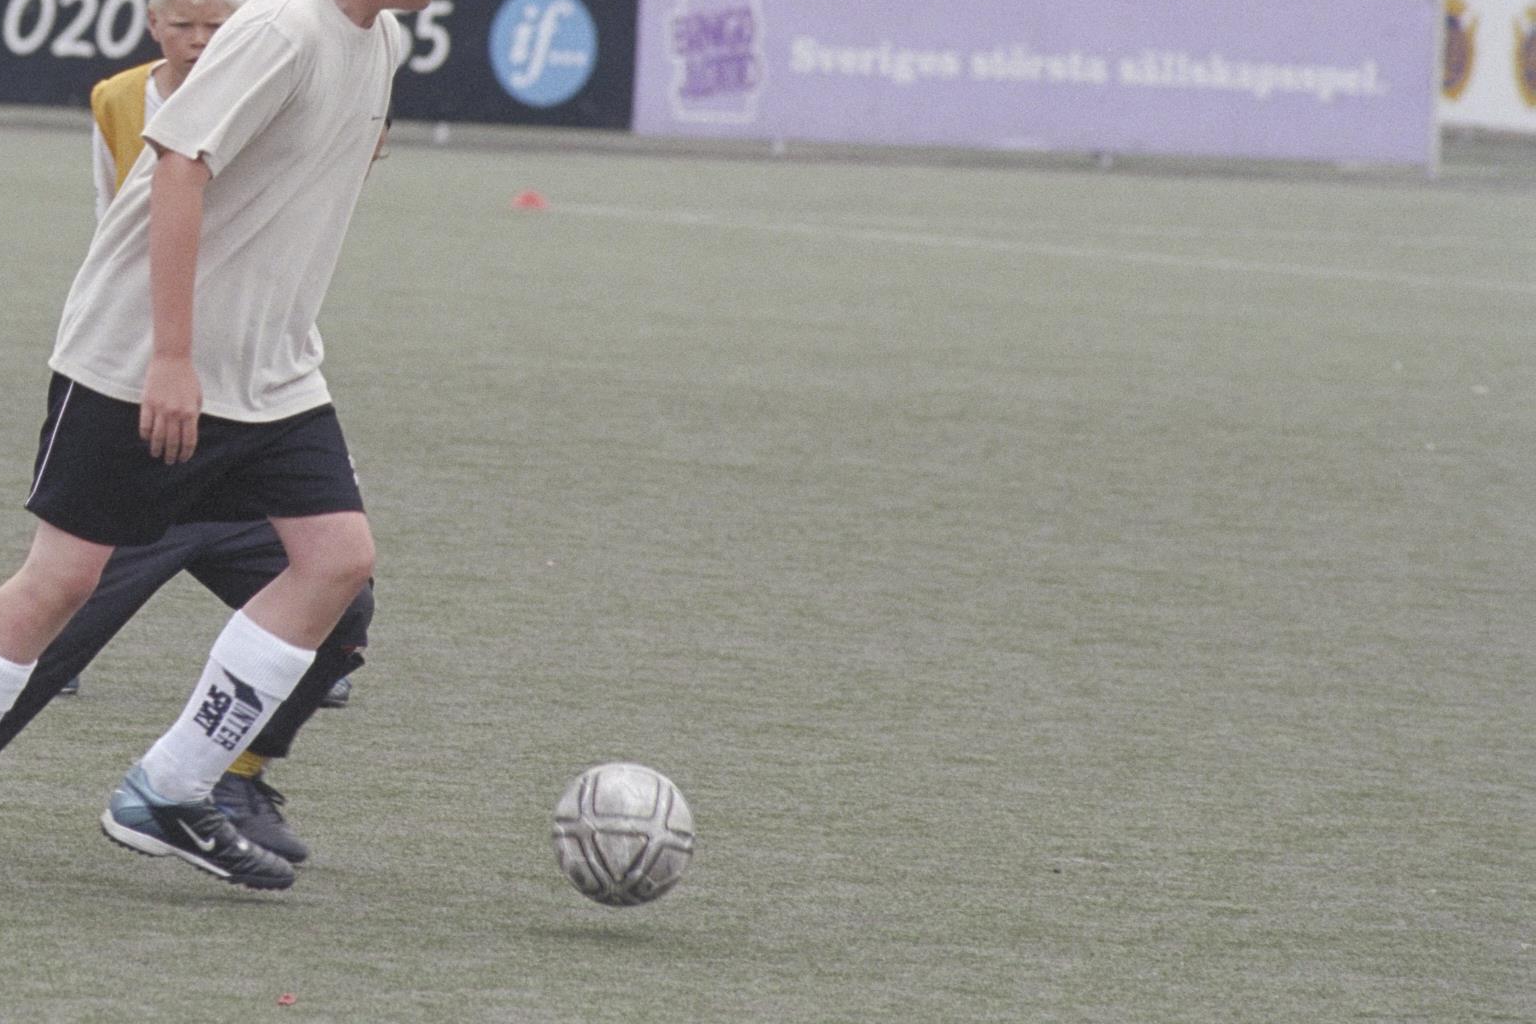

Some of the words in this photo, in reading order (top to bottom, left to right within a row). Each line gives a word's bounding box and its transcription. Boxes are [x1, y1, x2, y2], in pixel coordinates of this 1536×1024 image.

[791, 36, 960, 84] Sveriges
[193, 683, 232, 737] SPORT
[213, 700, 260, 751] INTER
